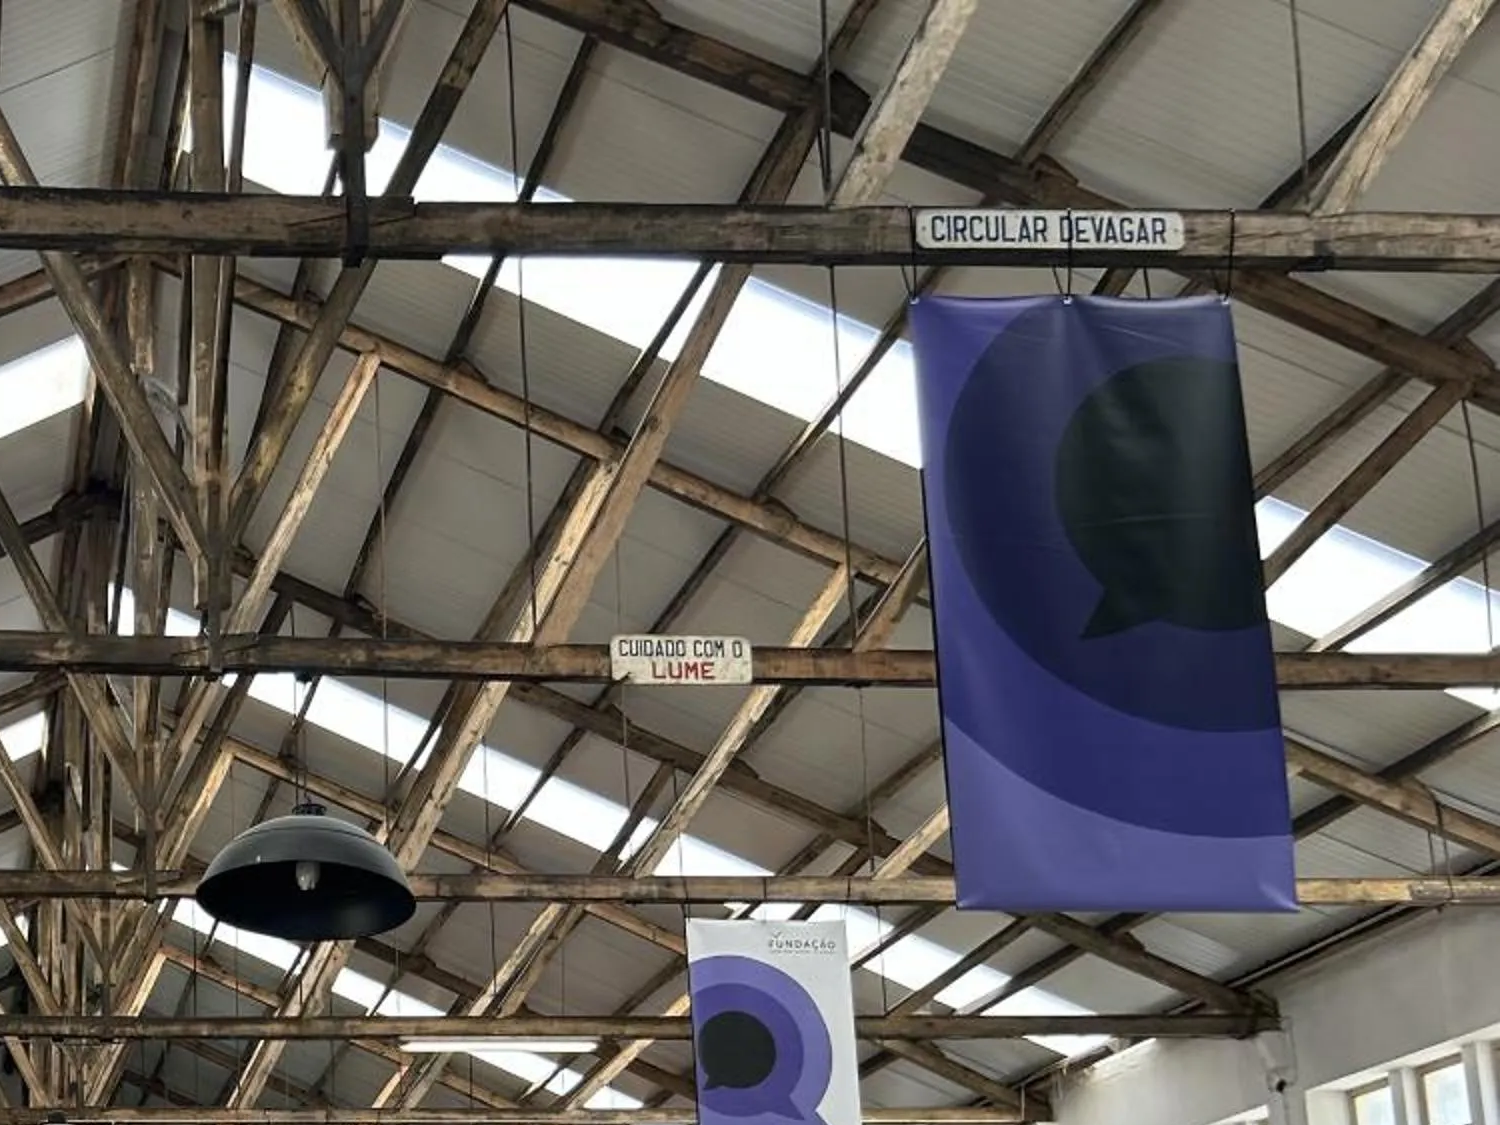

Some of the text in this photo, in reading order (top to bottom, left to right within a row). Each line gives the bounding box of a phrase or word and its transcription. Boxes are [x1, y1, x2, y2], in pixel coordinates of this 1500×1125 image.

[930, 215, 1167, 244] CIRCULAR DEVAGAR
[619, 639, 743, 658] CUIDADO COM O
[651, 661, 716, 679] LUME
